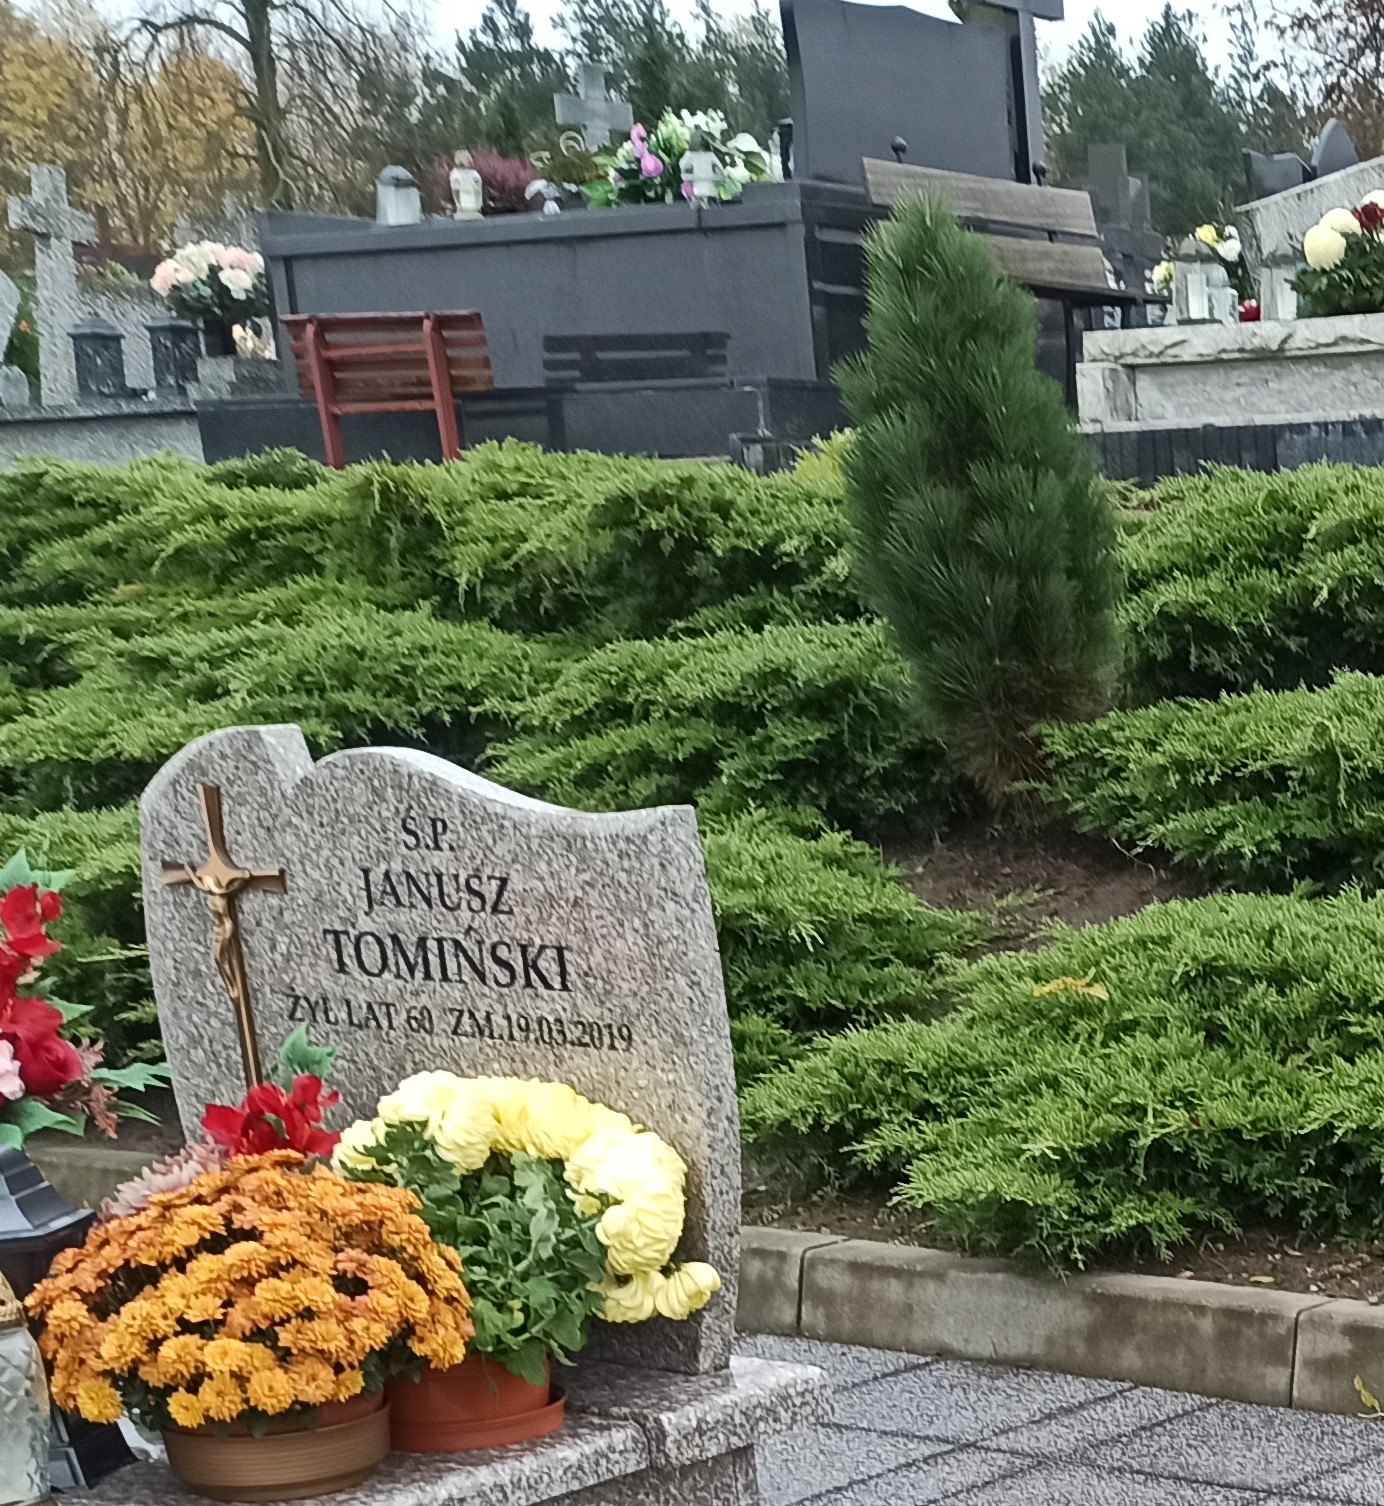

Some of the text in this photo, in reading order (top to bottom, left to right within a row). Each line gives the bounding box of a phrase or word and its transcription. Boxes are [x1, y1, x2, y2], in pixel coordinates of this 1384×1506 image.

[360, 867, 515, 917] JANUSZ
[322, 924, 573, 993] TOMIŃSKI
[346, 997, 399, 1032] LAT
[405, 1003, 436, 1036] 60
